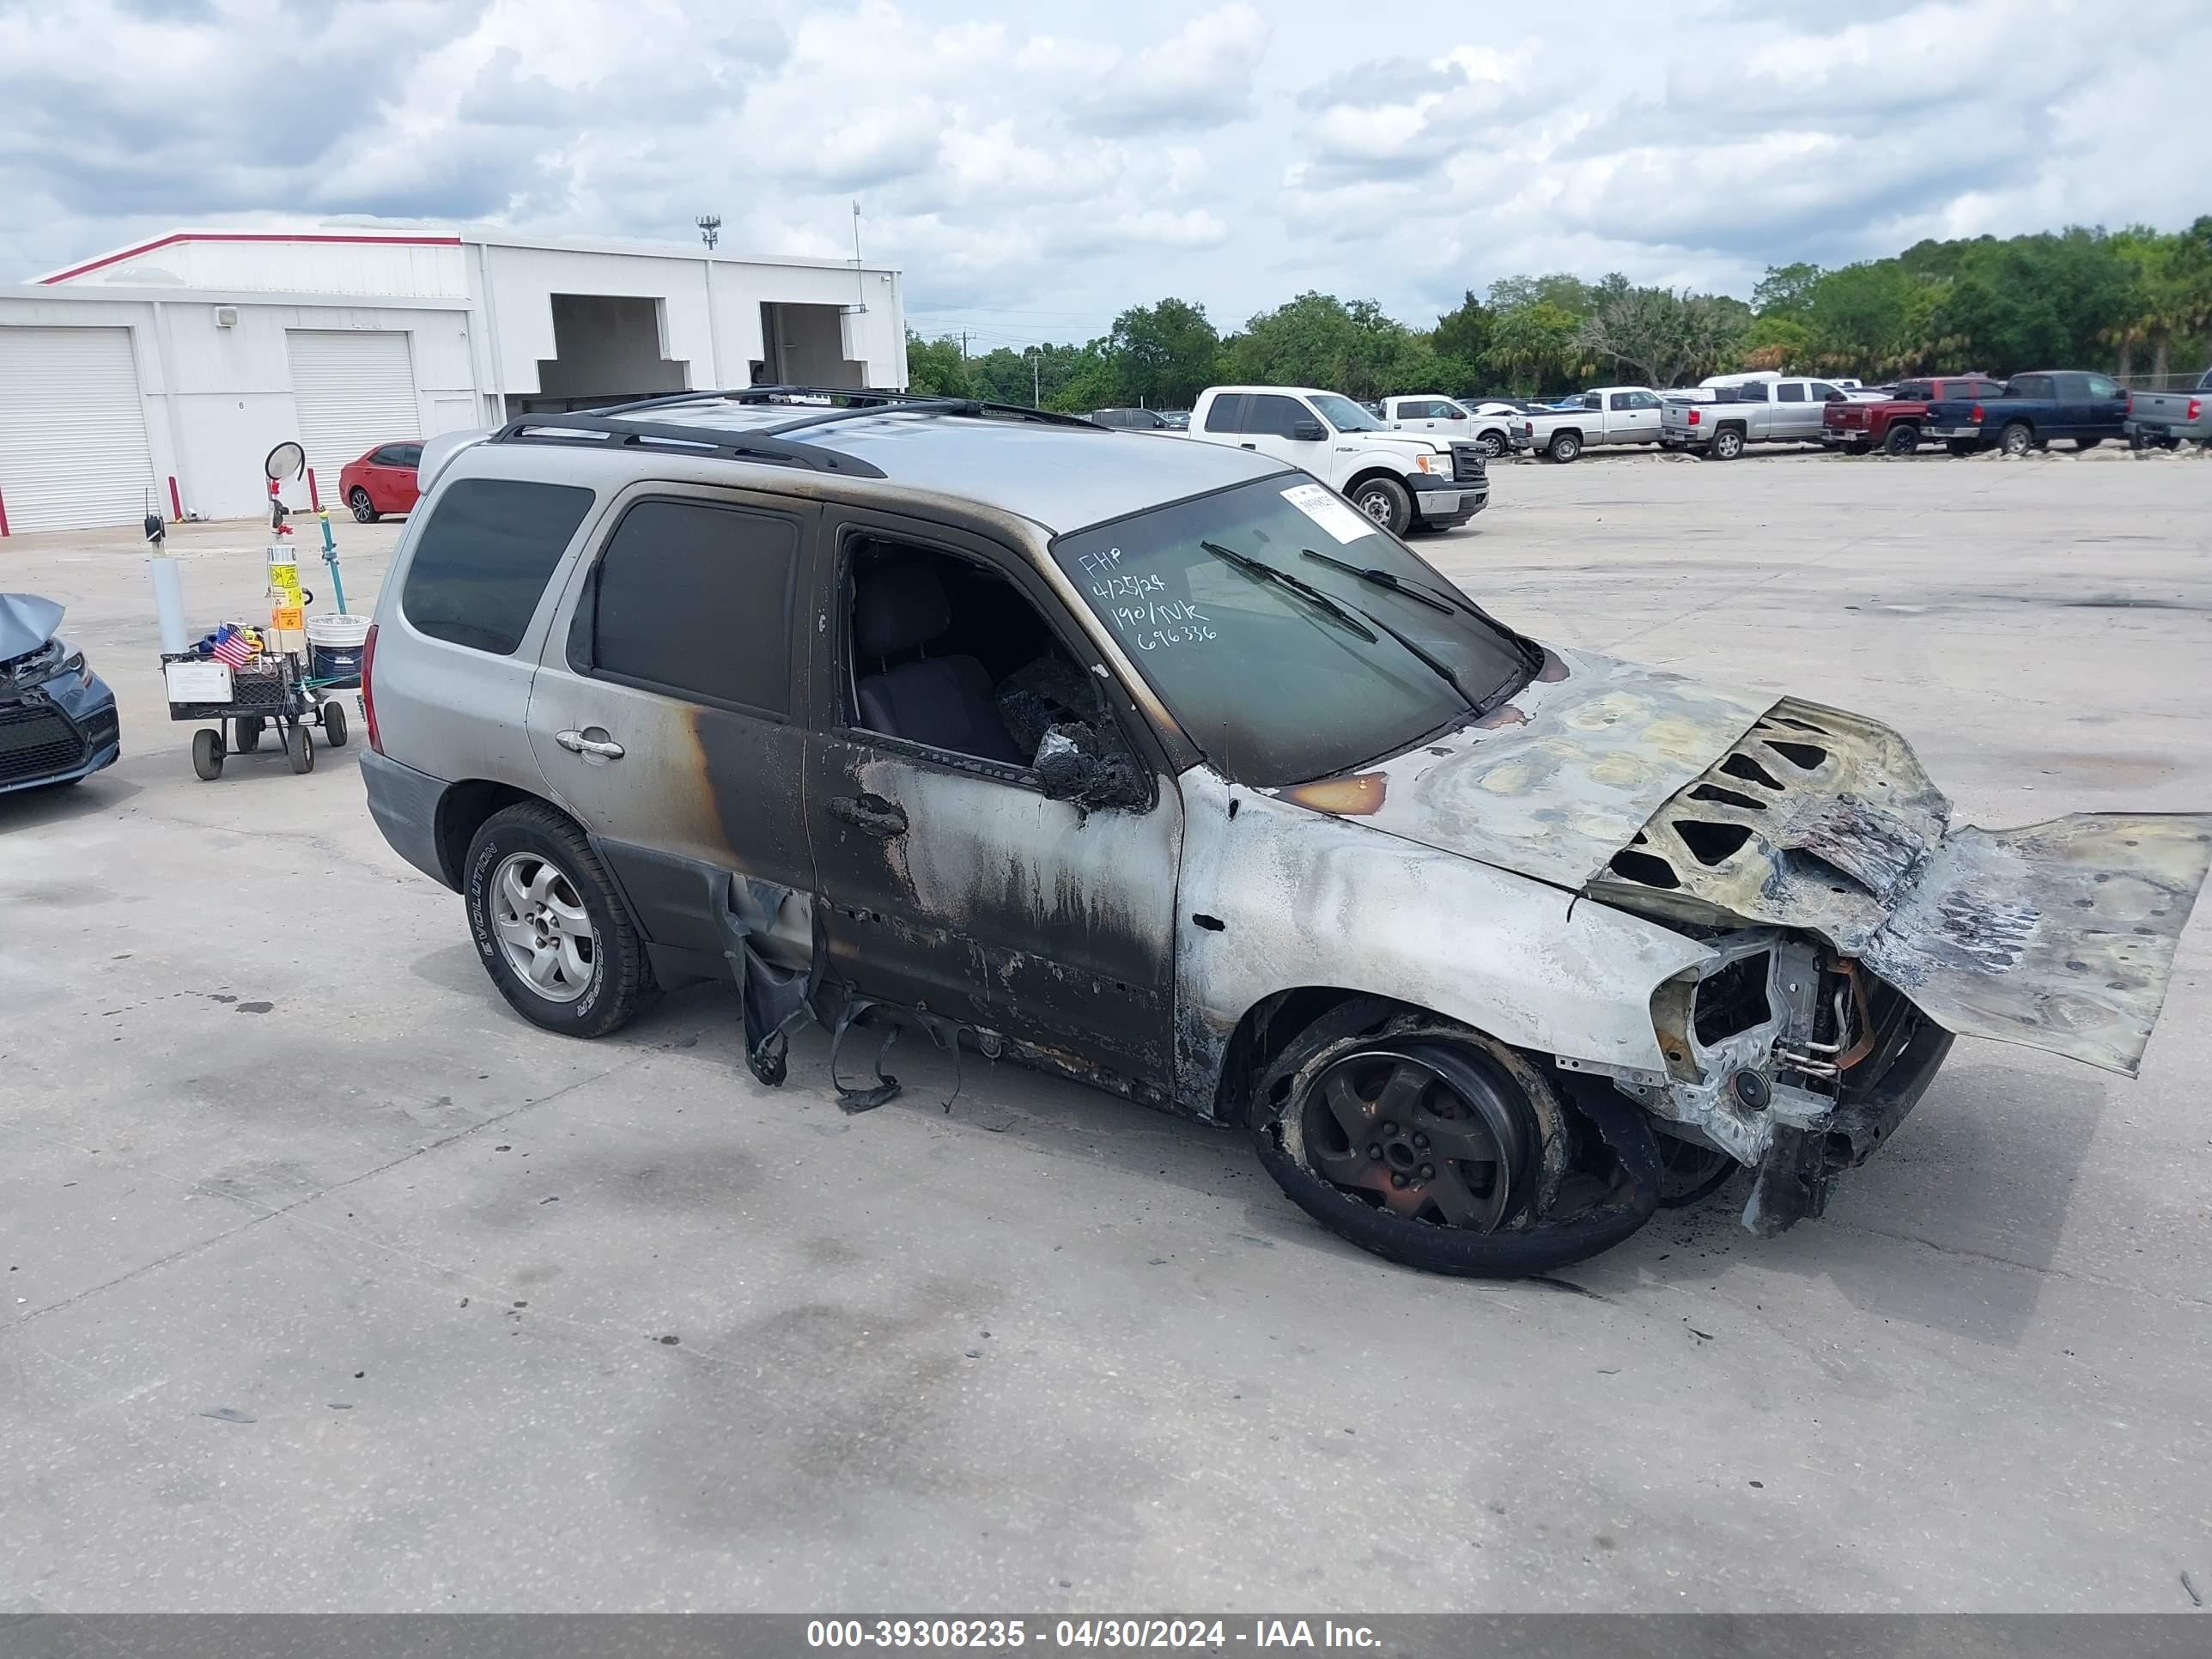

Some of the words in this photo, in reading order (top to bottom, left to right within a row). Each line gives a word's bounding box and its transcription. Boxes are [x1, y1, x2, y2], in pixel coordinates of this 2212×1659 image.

[1079, 548, 1121, 578] FHP
[1092, 574, 1165, 599] 4/25/24
[1137, 625, 1217, 650] 696336
[471, 842, 498, 957] EVOLUTION
[576, 927, 604, 1018] COOPER
